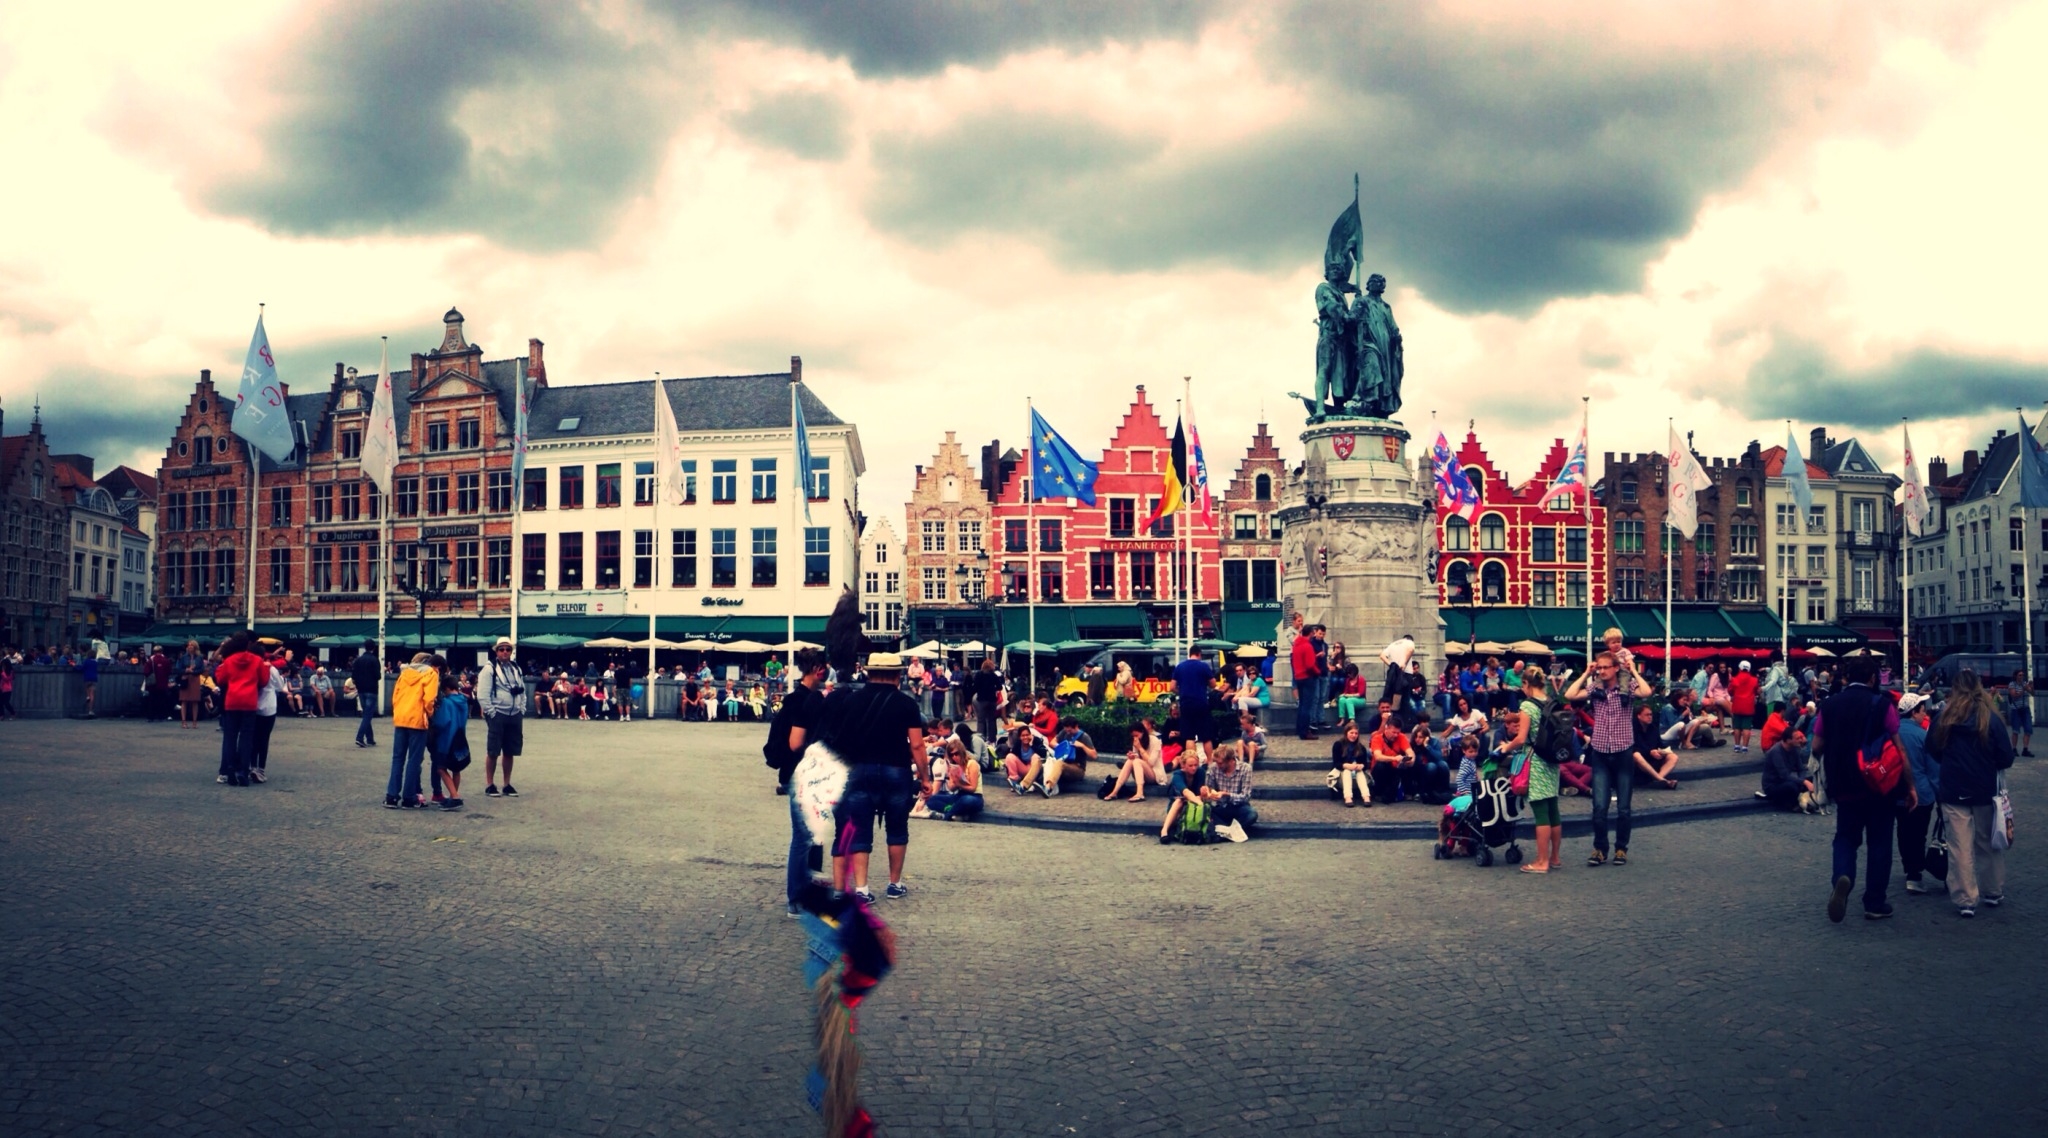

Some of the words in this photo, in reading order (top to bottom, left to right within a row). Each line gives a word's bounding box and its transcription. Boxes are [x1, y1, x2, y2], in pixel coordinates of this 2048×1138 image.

[332, 531, 363, 541] Jupiler
[434, 526, 468, 537] Jupiler
[1120, 541, 1157, 550] PANIER
[556, 603, 587, 612] BELFORT
